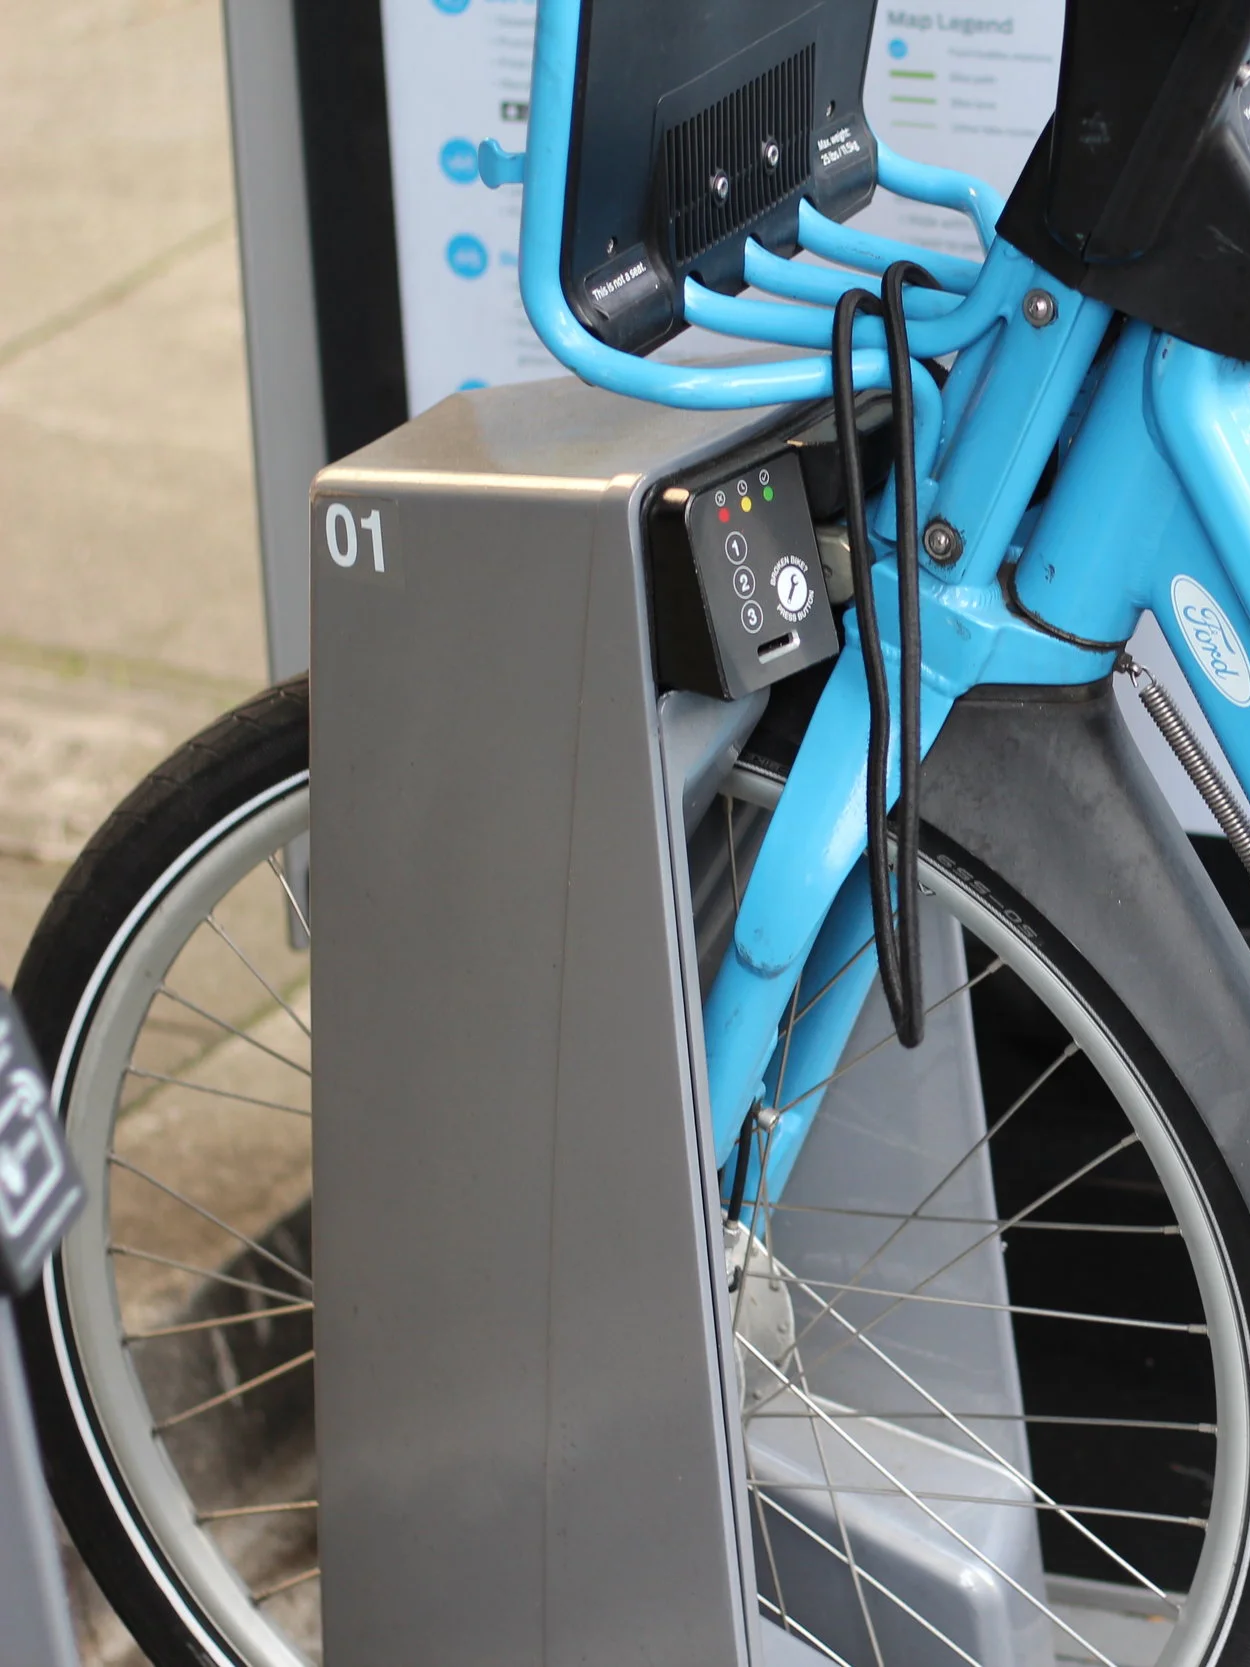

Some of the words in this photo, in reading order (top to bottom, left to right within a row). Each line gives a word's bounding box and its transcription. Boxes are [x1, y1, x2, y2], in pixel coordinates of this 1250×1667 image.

[887, 10, 932, 31] Map
[937, 13, 1014, 36] Legend
[820, 152, 831, 166] 25
[592, 286, 609, 301] This
[606, 281, 615, 293] is
[613, 273, 626, 290] not
[624, 271, 631, 282] a
[629, 261, 647, 279] seat.
[325, 502, 385, 573] 01
[769, 556, 790, 587] BROKEN
[790, 555, 809, 573] BIKE?
[777, 603, 797, 623] PRESS
[797, 589, 815, 622] BUTTON
[1183, 604, 1239, 681] Ford
